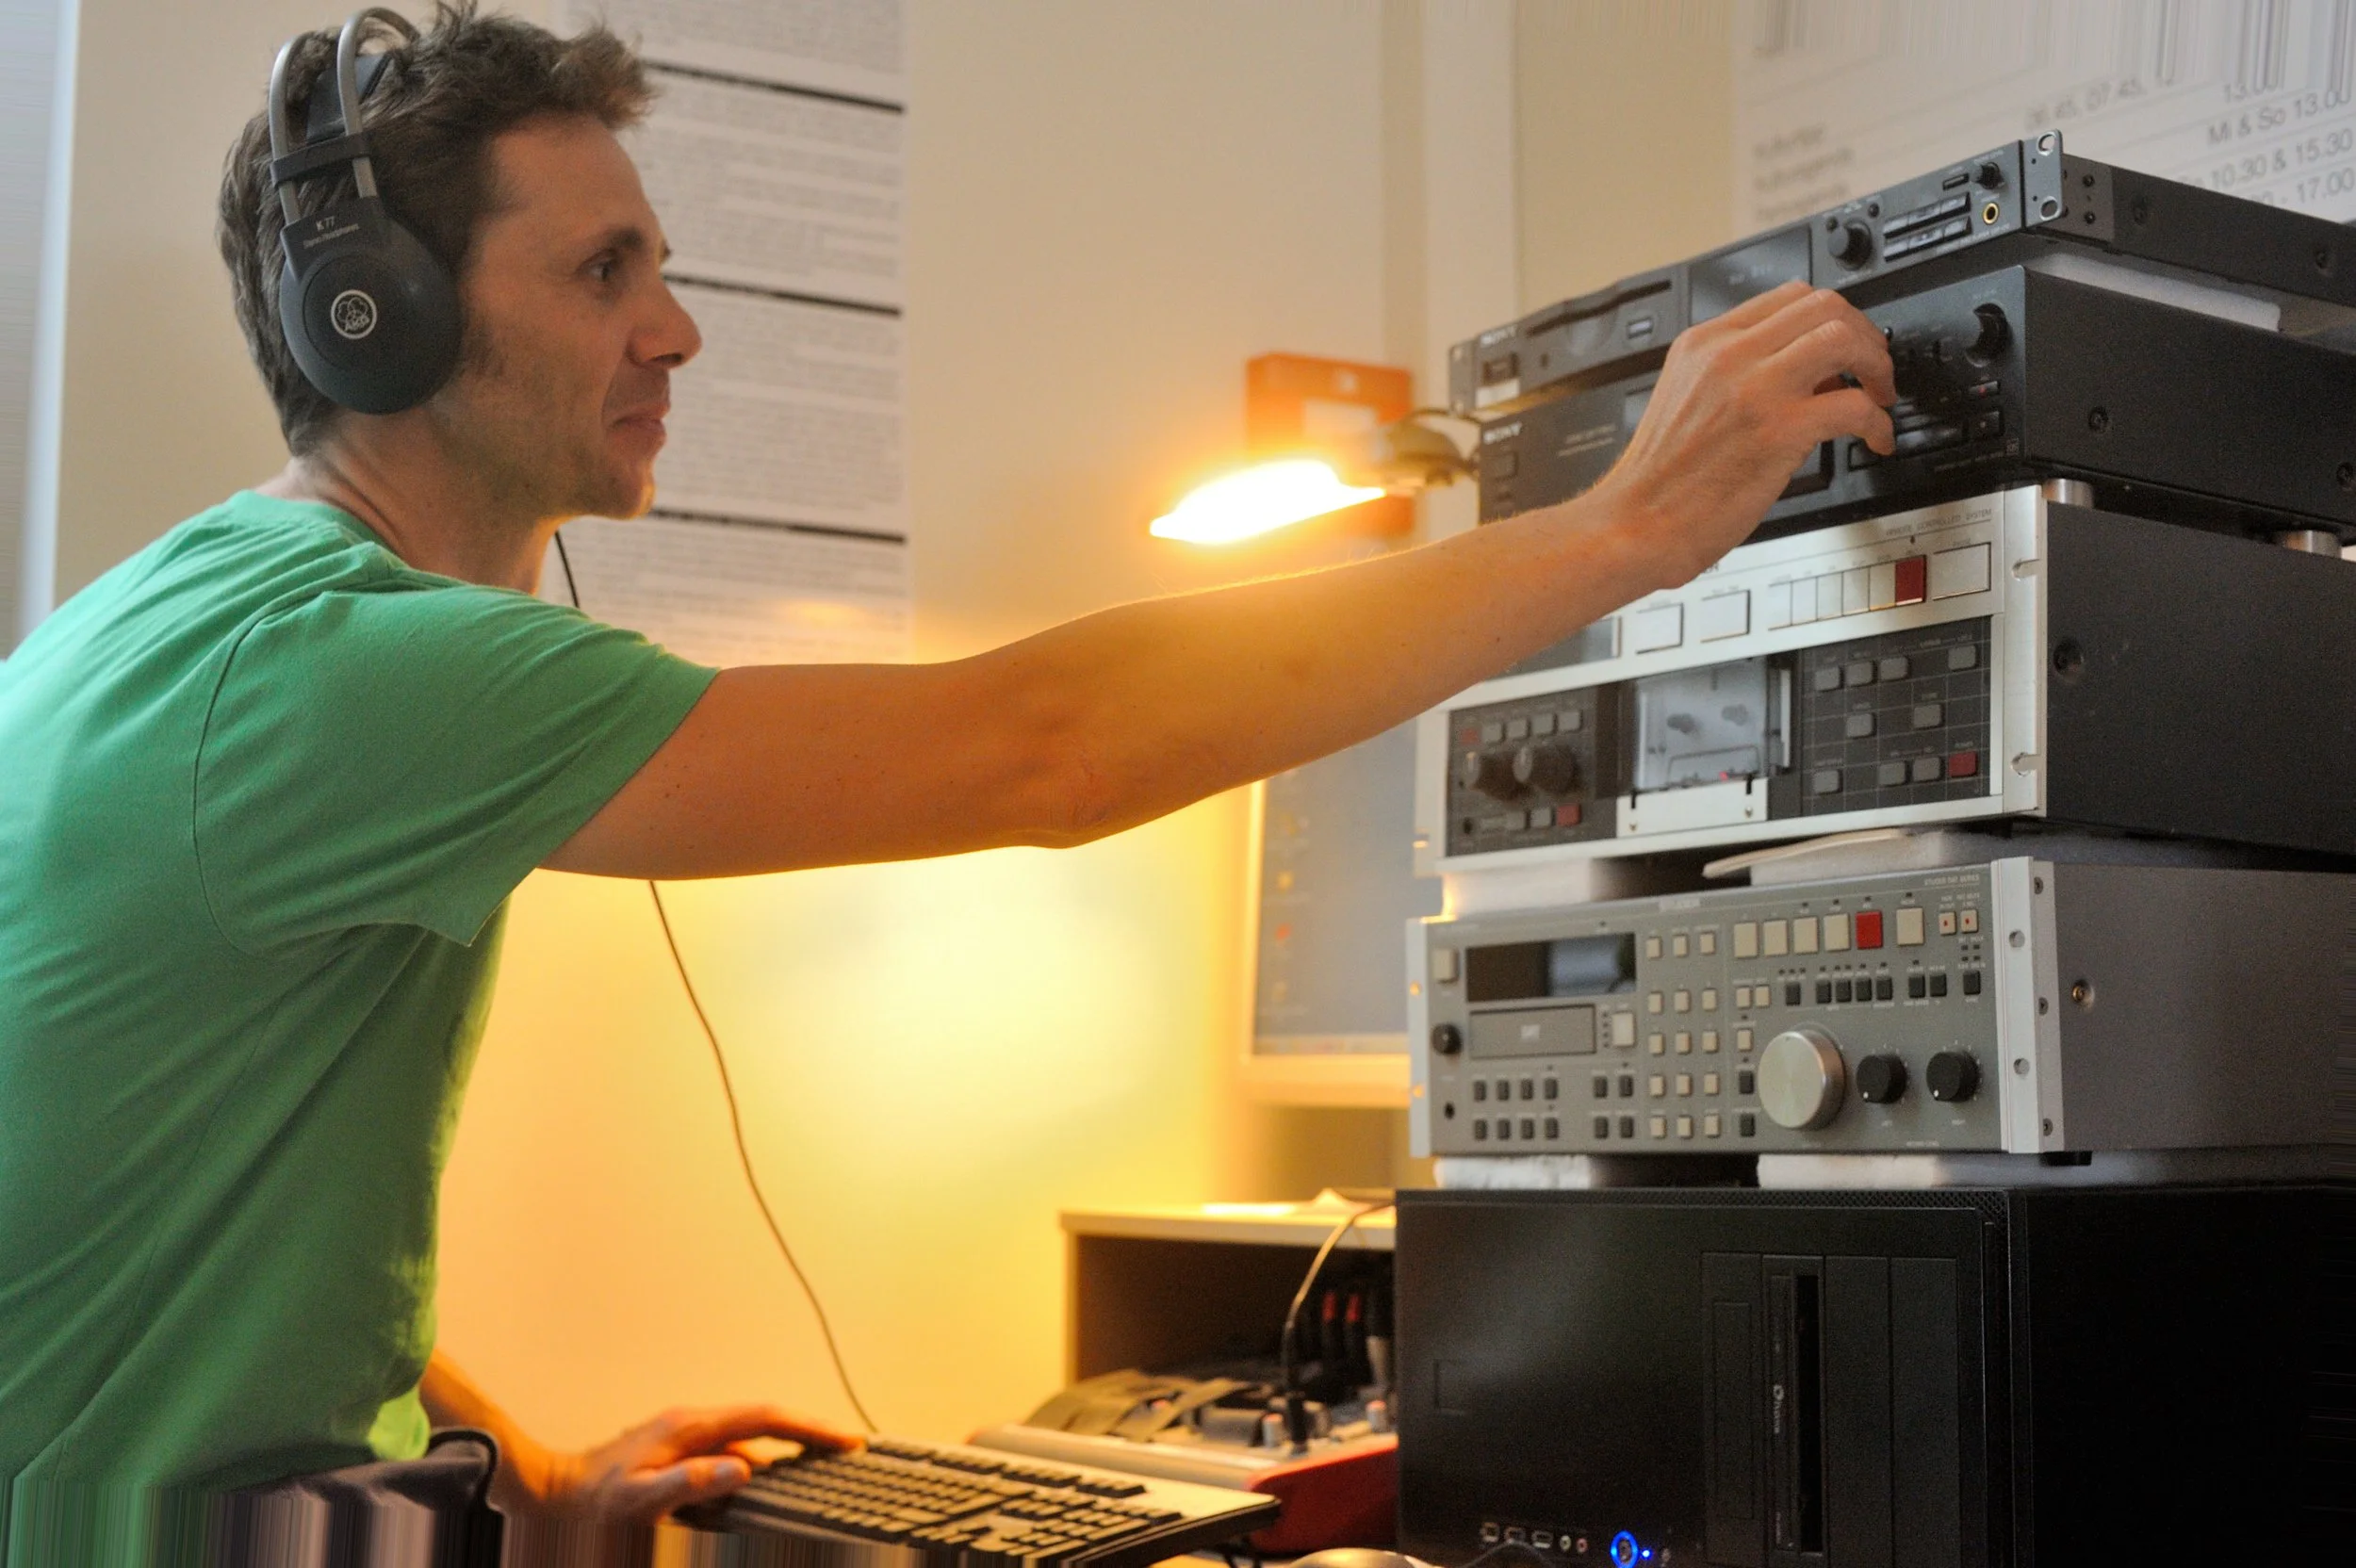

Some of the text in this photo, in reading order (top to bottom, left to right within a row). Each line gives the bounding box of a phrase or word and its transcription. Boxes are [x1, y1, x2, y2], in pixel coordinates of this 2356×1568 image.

[2258, 106, 2286, 130] So
[2272, 148, 2287, 172] &
[2295, 127, 2354, 165] 15.30
[2297, 166, 2356, 204] 17.00
